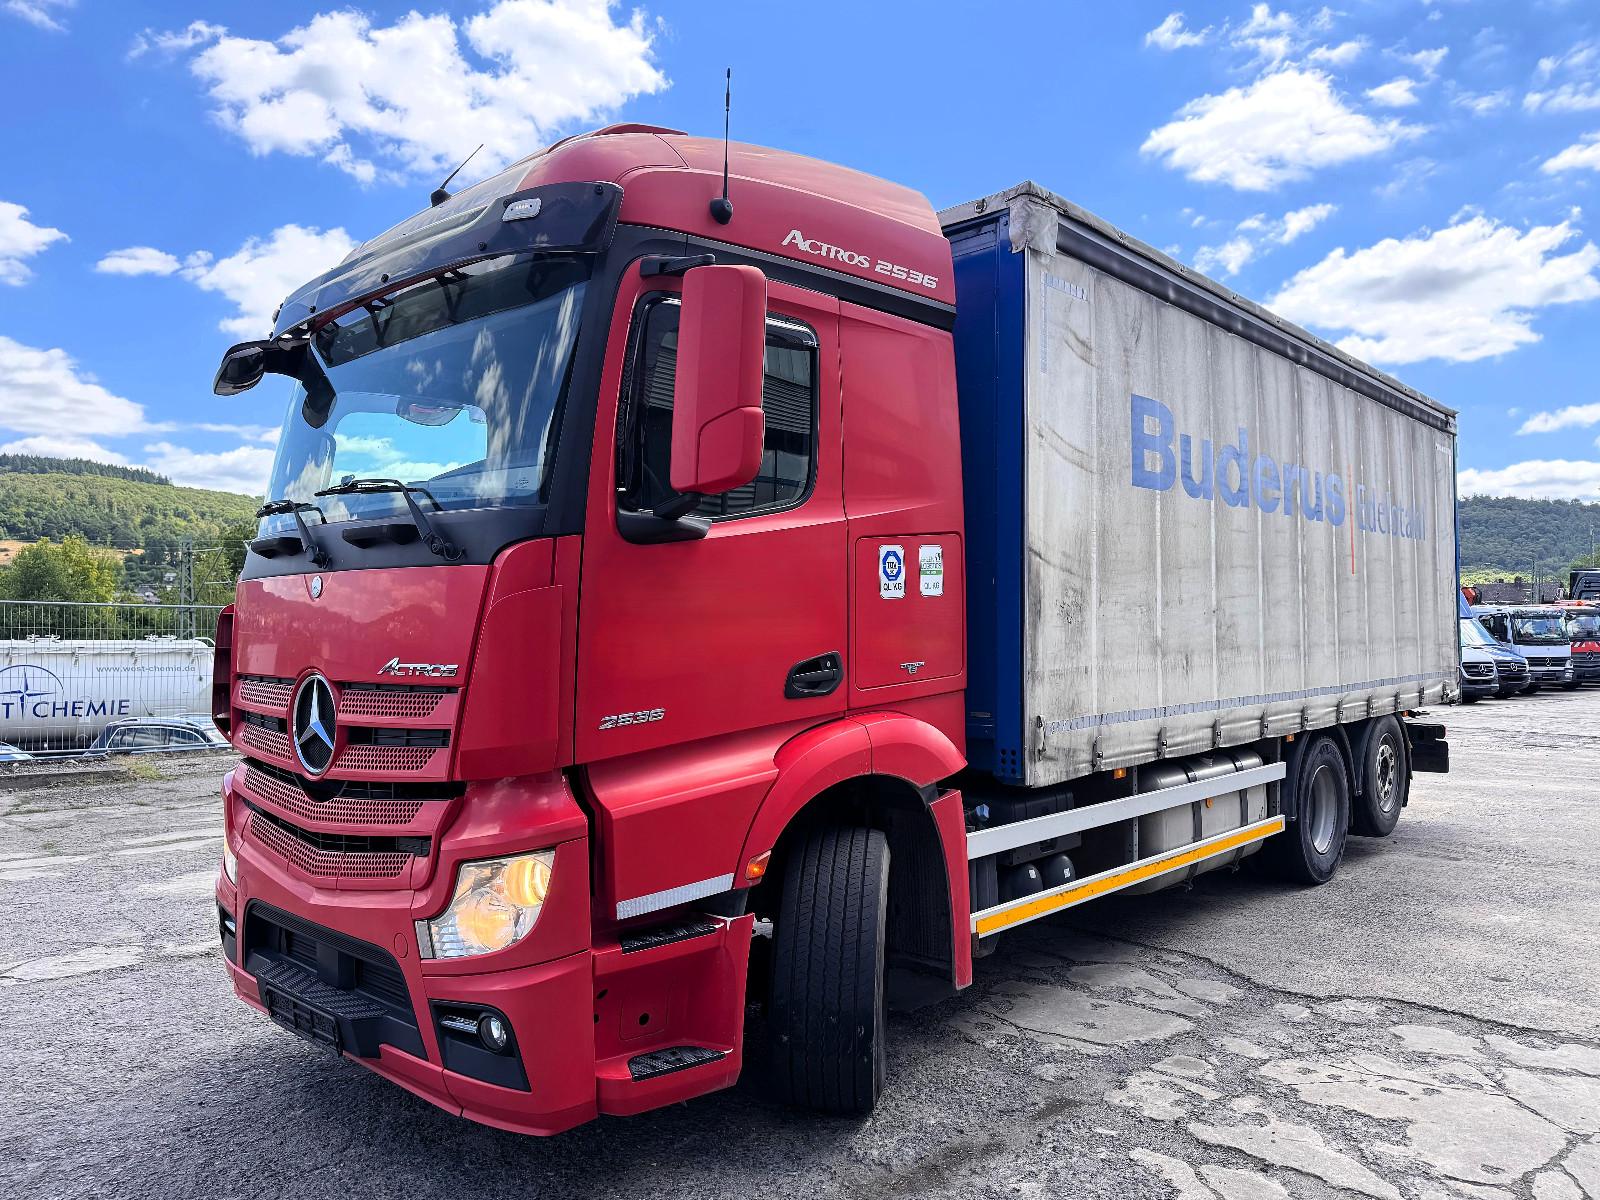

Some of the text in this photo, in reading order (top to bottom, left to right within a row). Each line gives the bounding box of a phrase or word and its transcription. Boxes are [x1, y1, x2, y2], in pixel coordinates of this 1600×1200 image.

[781, 229, 938, 289] ACTROS 2536
[1130, 393, 1346, 526] Buderus
[32, 698, 130, 718] CHEMIE
[598, 707, 666, 730] 2536
